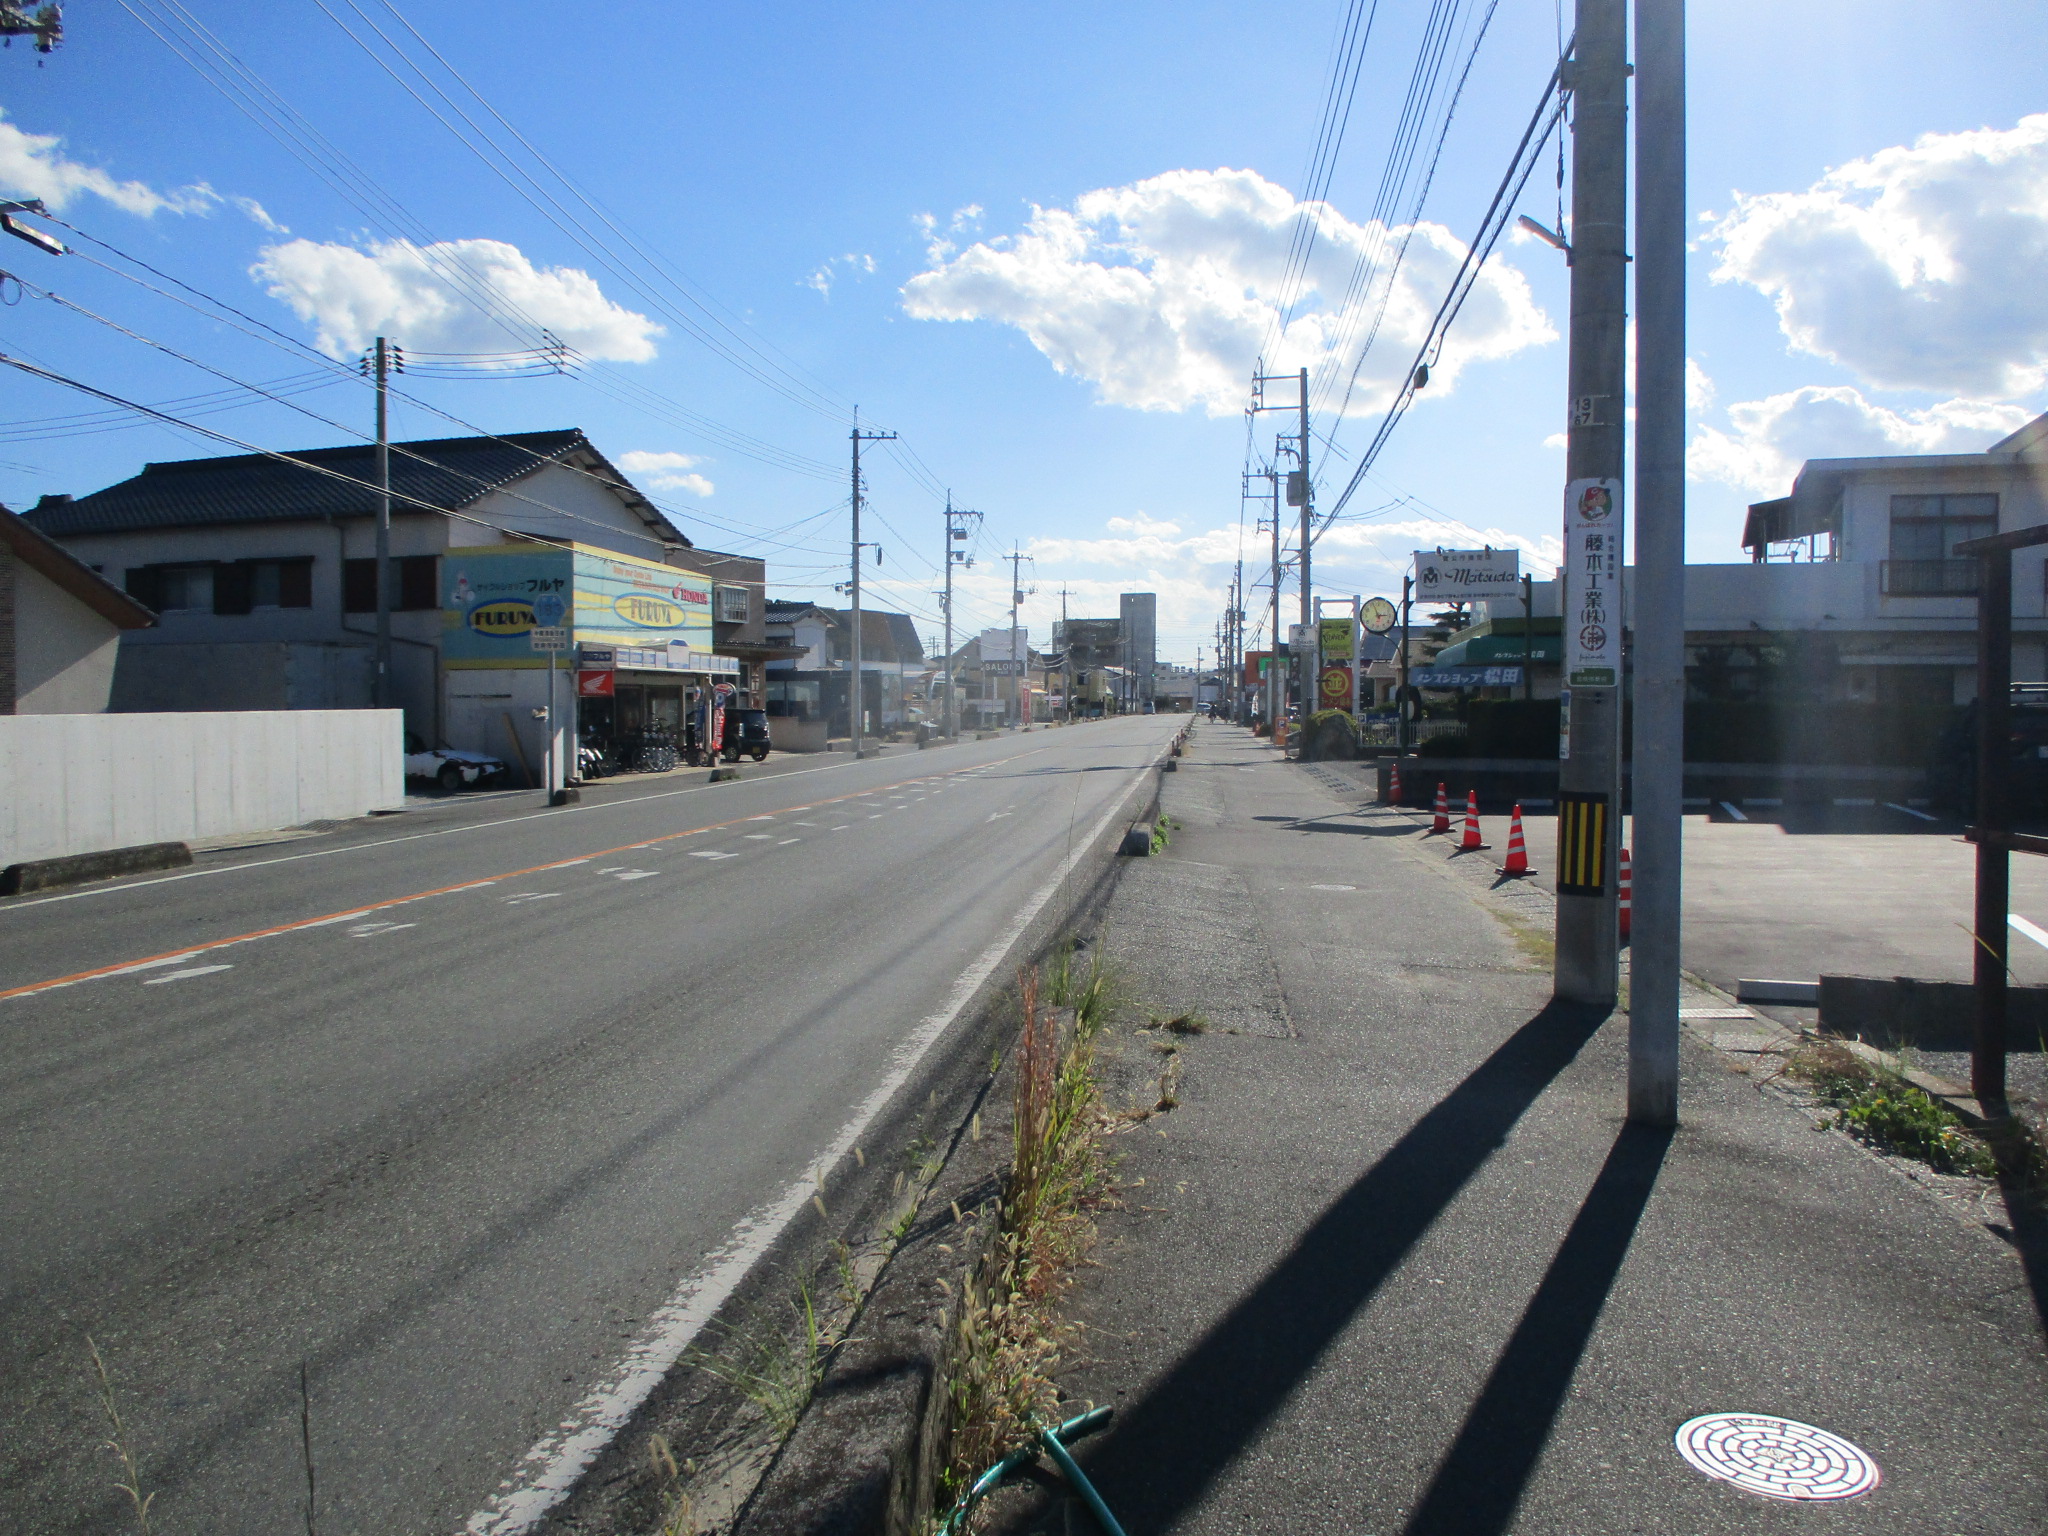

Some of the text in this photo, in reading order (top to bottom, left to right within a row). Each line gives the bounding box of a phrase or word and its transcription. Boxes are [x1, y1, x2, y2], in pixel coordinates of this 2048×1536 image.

[1575, 398, 1592, 412] 13
[1445, 568, 1515, 586] Matsuda
[1581, 533, 1606, 625] 藤本工業(株)
[681, 588, 709, 605] HONDA
[629, 597, 672, 625] FURUYA
